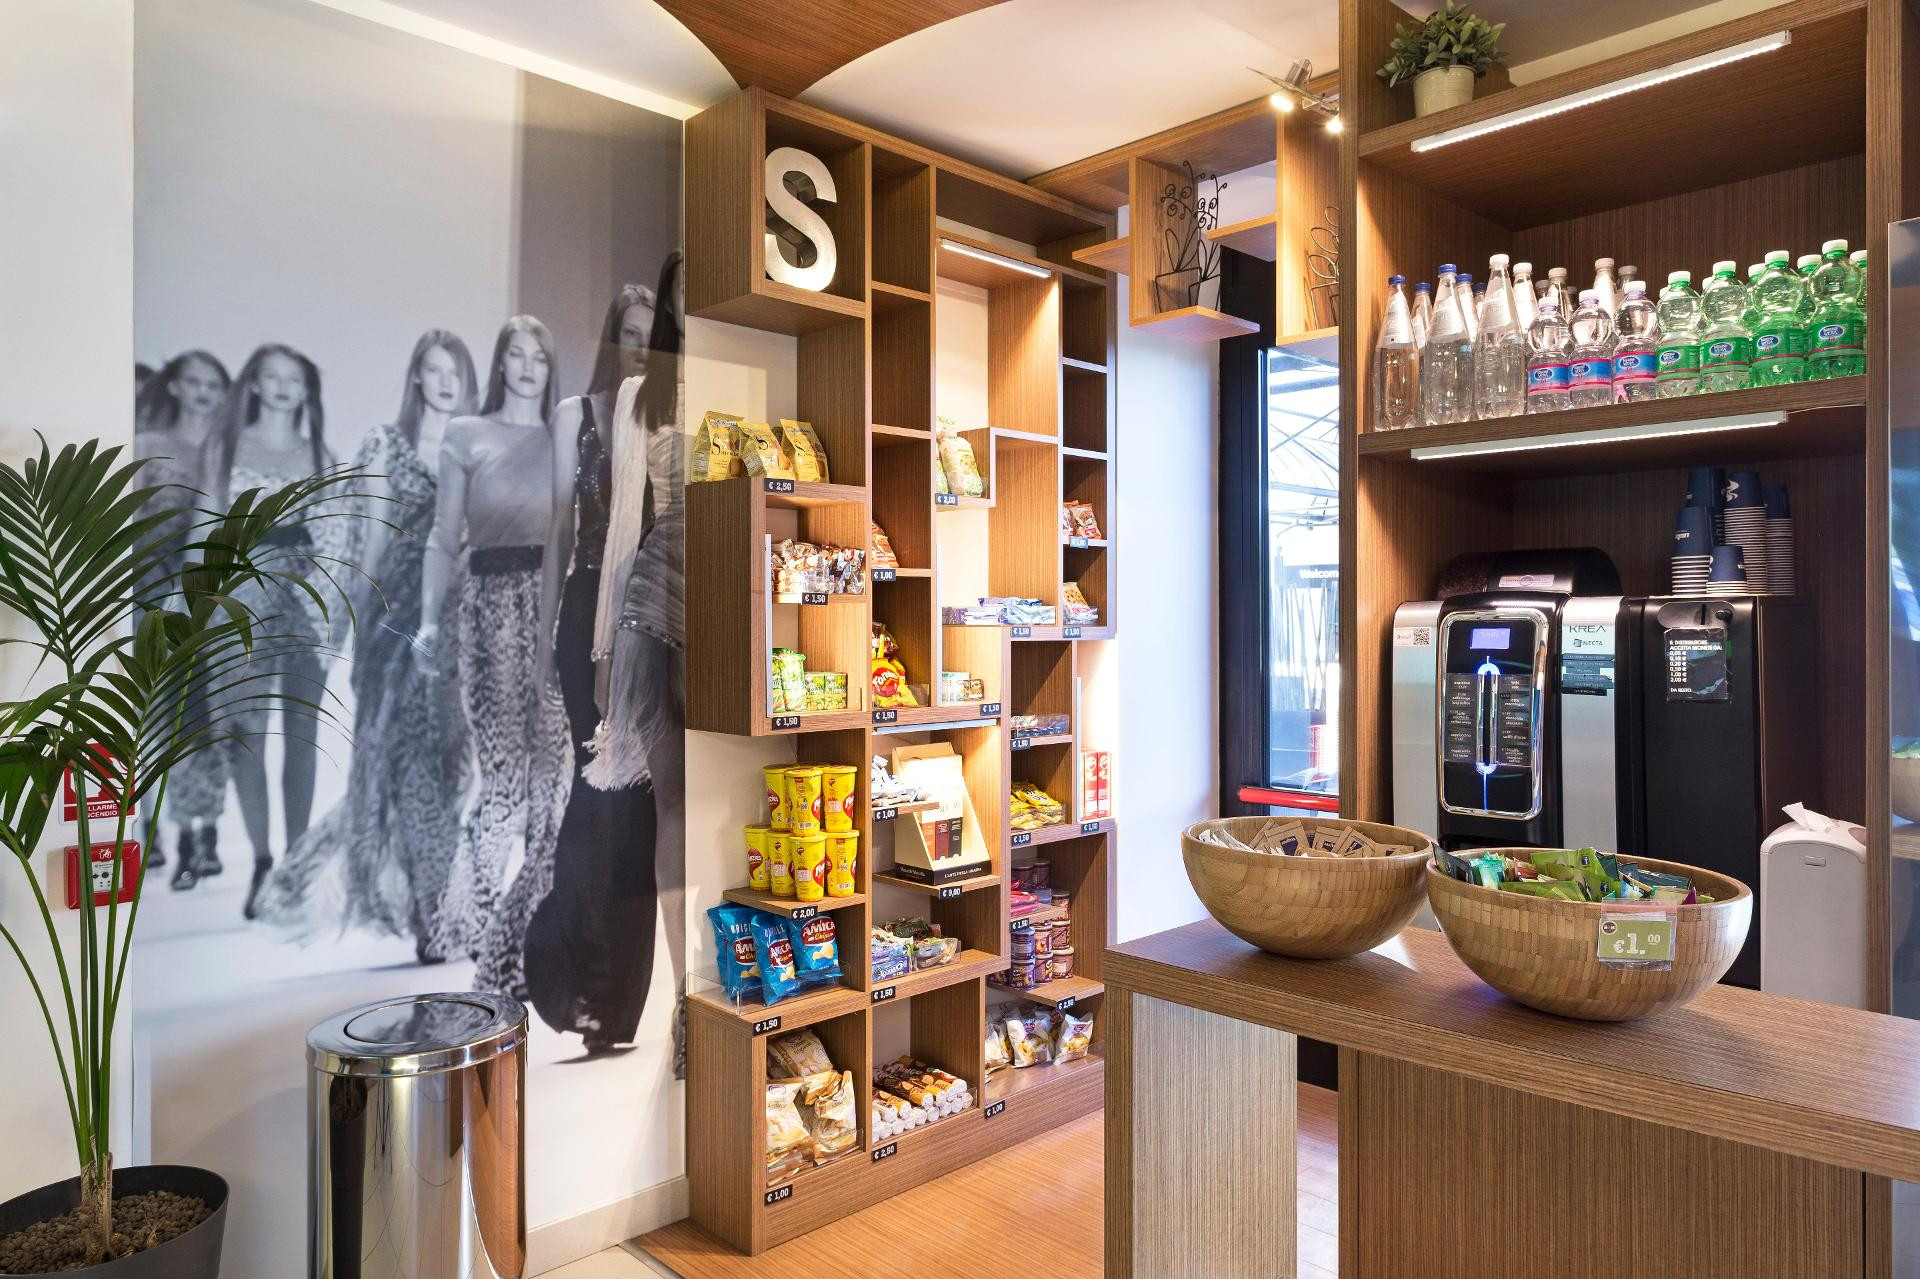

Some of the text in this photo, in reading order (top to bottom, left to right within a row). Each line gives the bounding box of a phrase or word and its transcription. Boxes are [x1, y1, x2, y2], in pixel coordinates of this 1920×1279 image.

[765, 147, 838, 292] S
[768, 482, 792, 492] € 2,50
[937, 495, 956, 505] € 2,00
[880, 571, 893, 581] 1,00
[1299, 568, 1339, 579] Welcom
[804, 594, 826, 604] € 1,50
[982, 704, 1000, 713] € 1,50
[775, 716, 798, 727] € 1,50
[88, 803, 117, 812] LLARME
[88, 810, 118, 818] NCENDIO
[882, 810, 895, 820] 1,00
[792, 907, 815, 919] € 2,00
[730, 922, 752, 933] ORIGI
[873, 989, 893, 1000] € 1,50
[755, 1019, 778, 1033] € 1,50
[986, 1103, 1003, 1116] € 1,00
[874, 1151, 880, 1160] €
[766, 1187, 789, 1202] € 1,00
